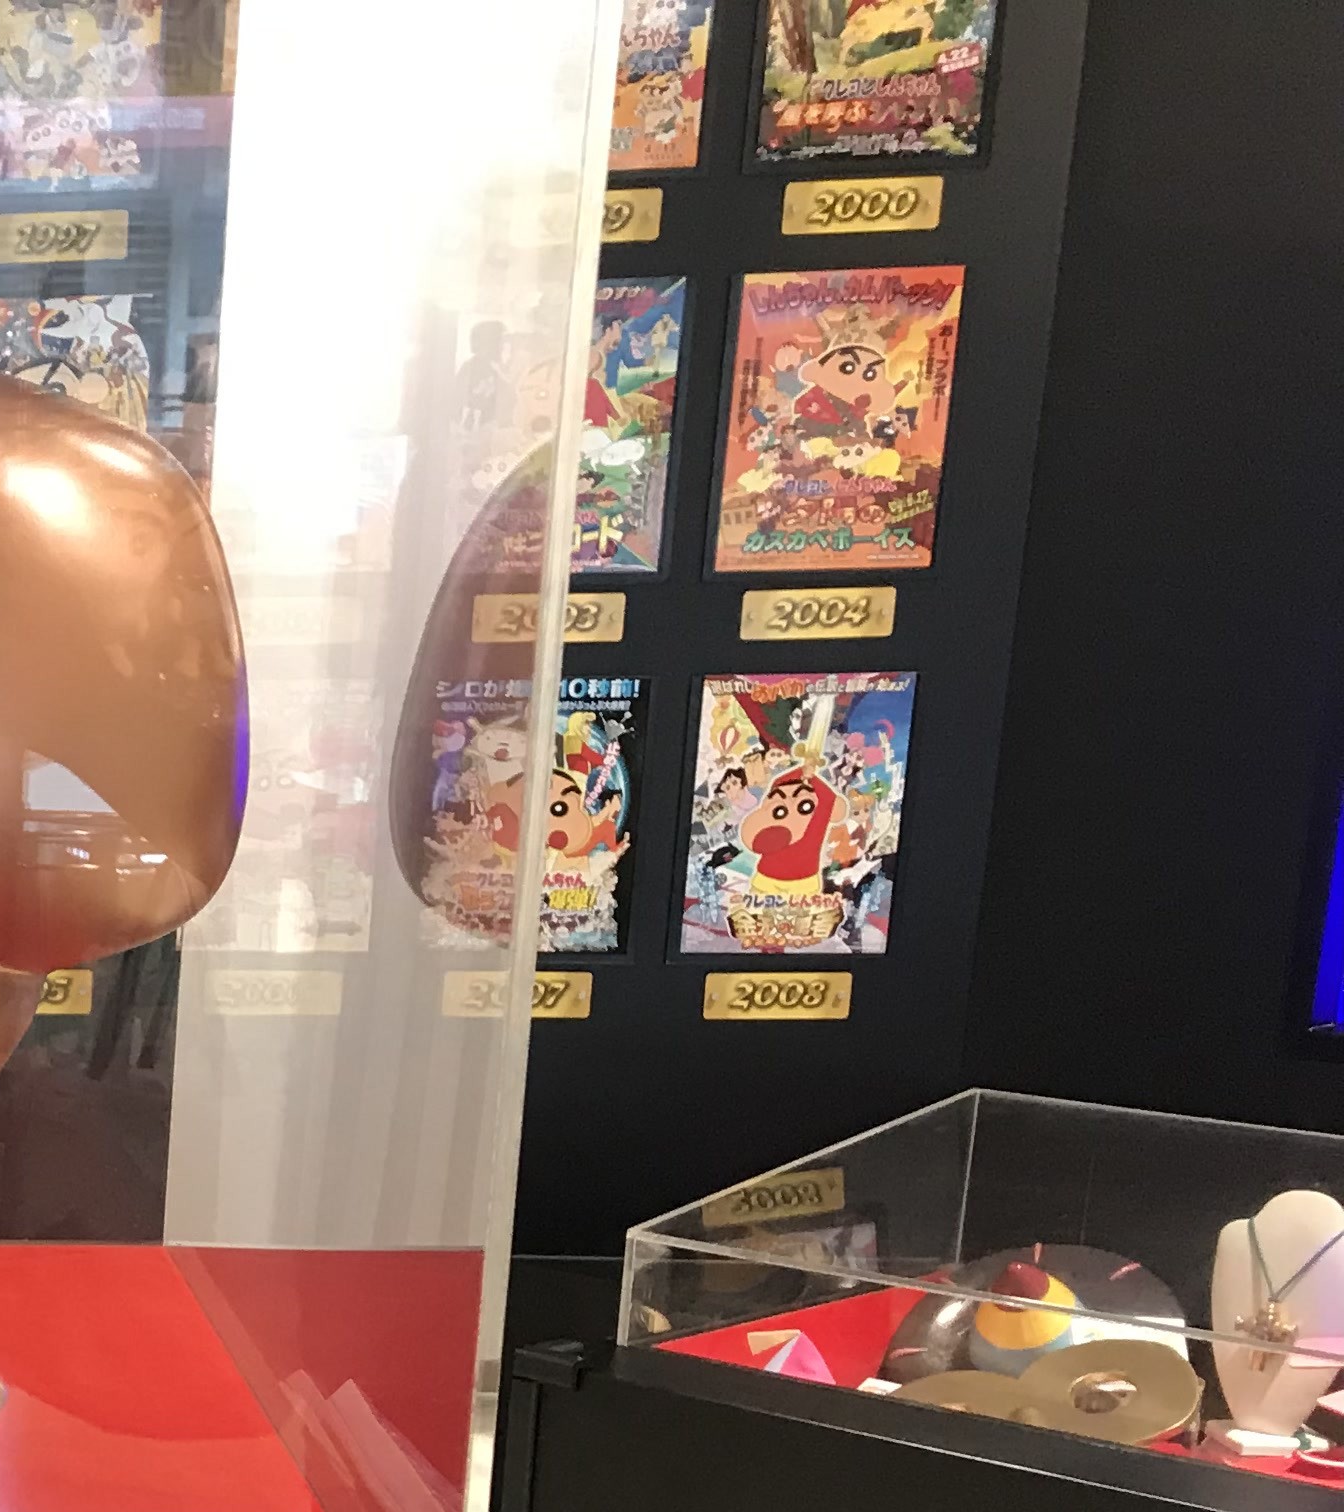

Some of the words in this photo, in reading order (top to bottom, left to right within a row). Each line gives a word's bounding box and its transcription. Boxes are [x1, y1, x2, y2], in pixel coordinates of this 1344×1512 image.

[806, 186, 920, 227] 2000
[764, 596, 870, 632] 2004
[727, 979, 832, 1012] 2008
